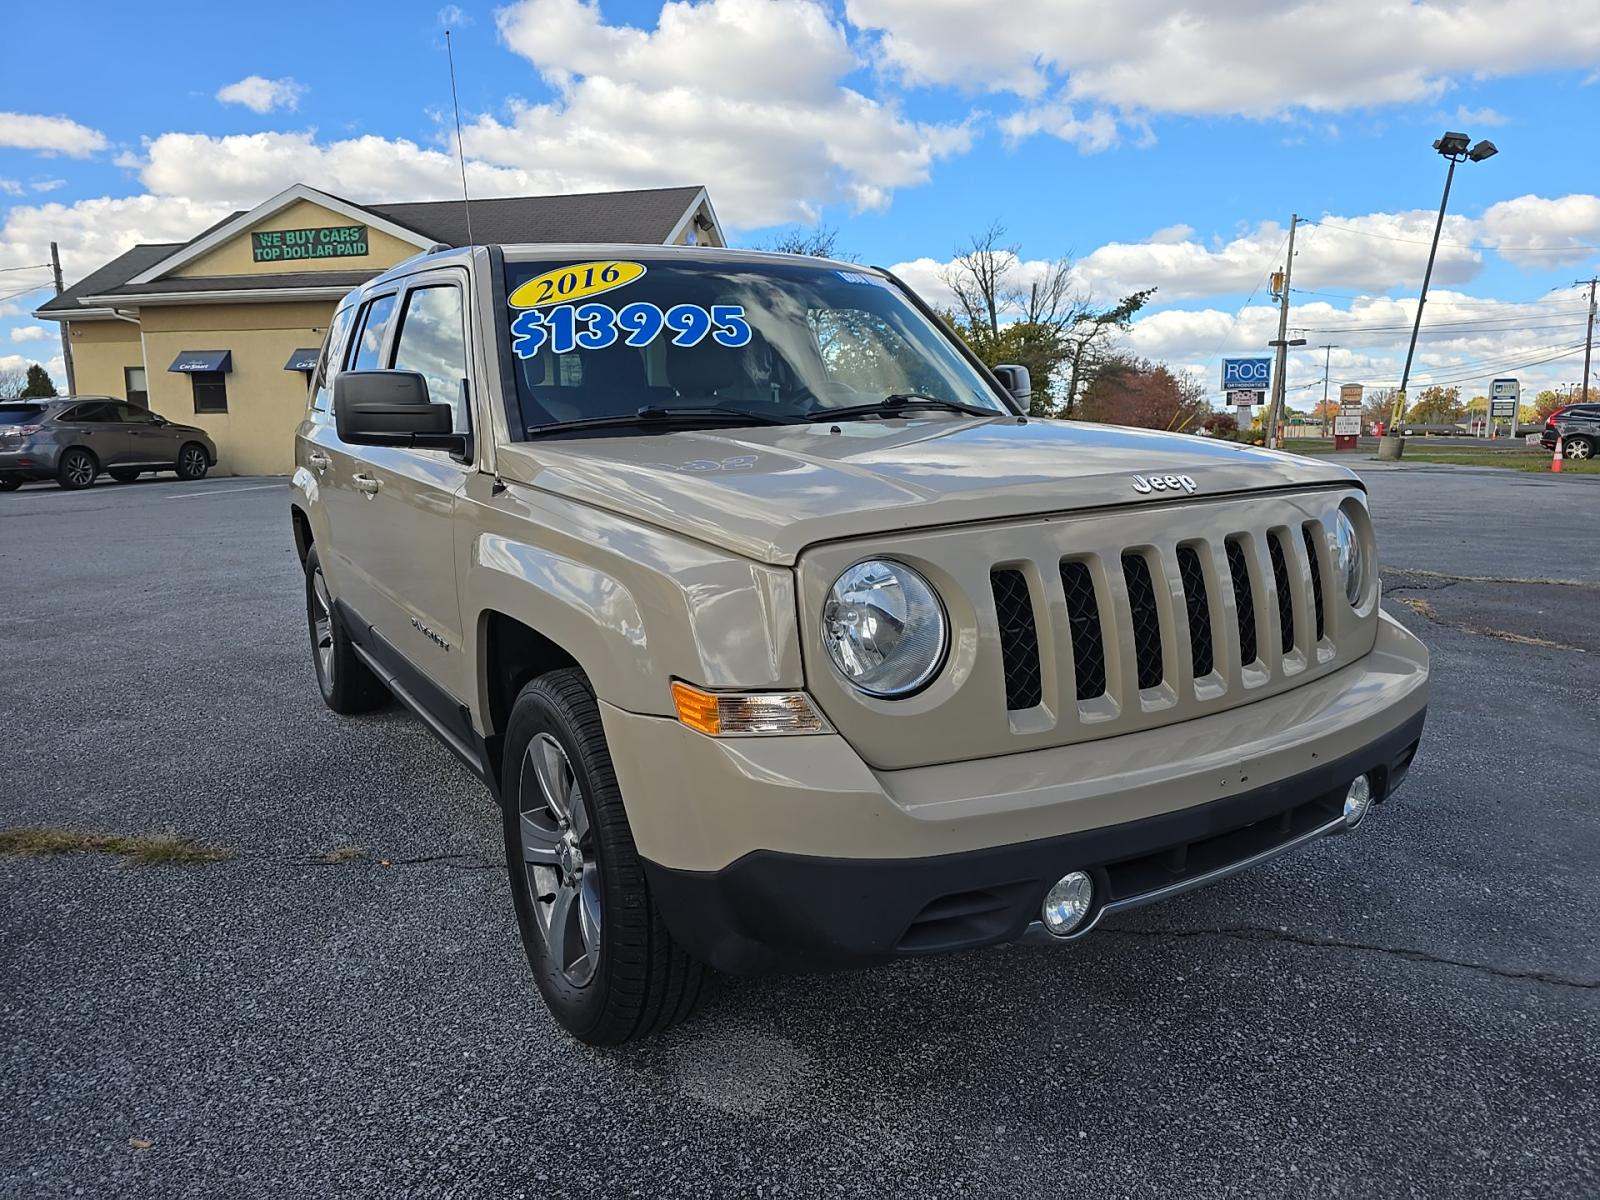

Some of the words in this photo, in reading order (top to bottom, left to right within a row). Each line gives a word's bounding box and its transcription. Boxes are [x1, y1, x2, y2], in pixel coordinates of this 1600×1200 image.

[259, 233, 282, 247] WE
[286, 231, 316, 245] BUY
[319, 228, 360, 243] CARS
[255, 248, 280, 260] TOP
[284, 244, 333, 258] DOLLAR
[337, 243, 367, 255] PAID
[535, 263, 620, 303] 2016
[511, 302, 752, 359] $13995
[1227, 363, 1267, 379] ROG
[1132, 474, 1197, 495] Jeep
